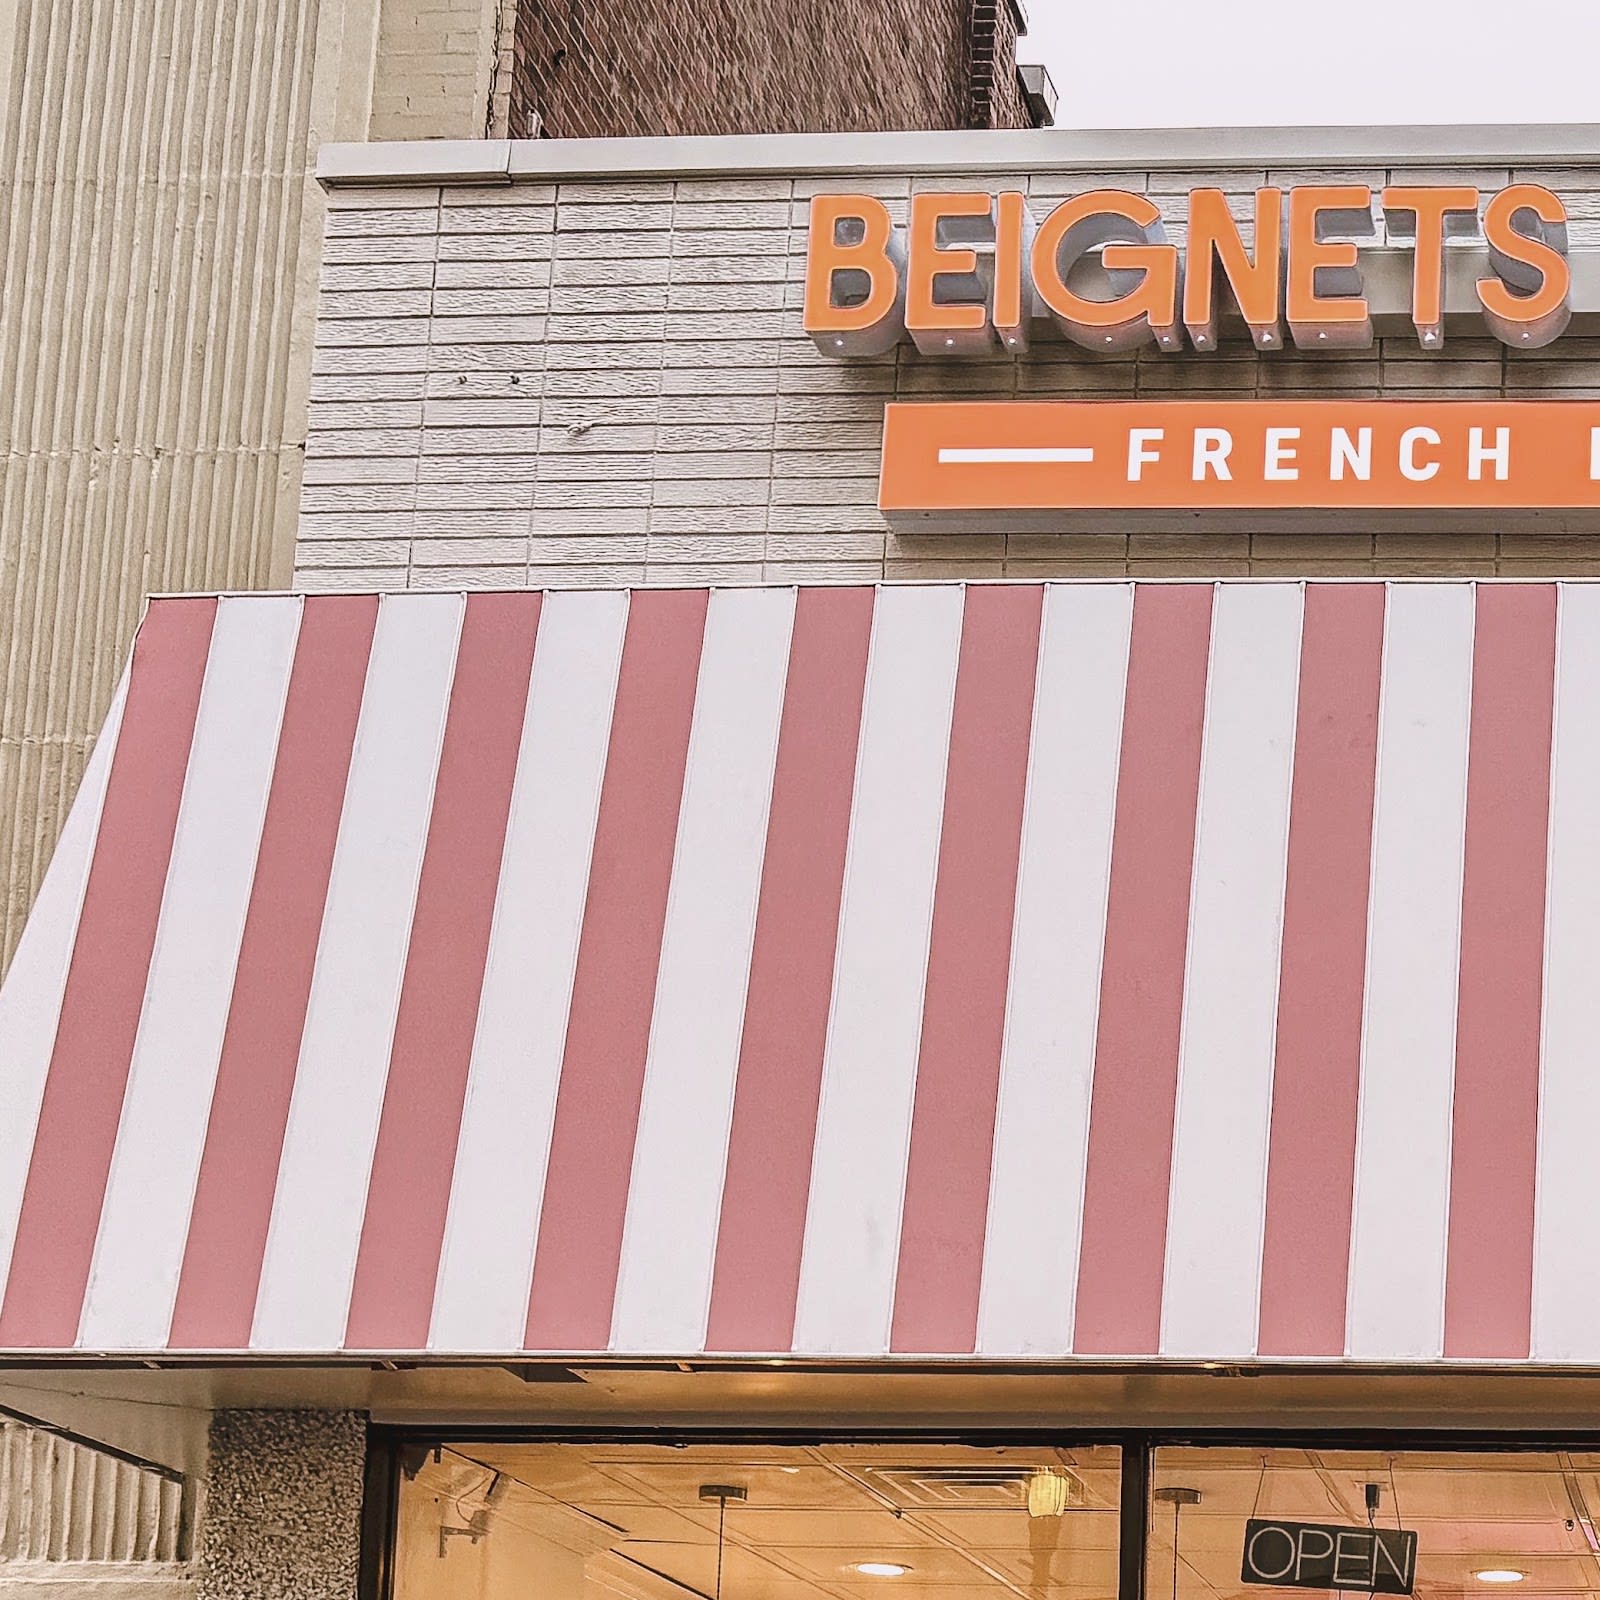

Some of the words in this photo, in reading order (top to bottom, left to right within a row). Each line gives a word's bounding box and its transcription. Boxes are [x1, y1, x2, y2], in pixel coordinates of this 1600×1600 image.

[802, 183, 1571, 334] BEIGNETS
[1126, 426, 1510, 482] FRENCH
[1247, 1525, 1413, 1590] OPEN
